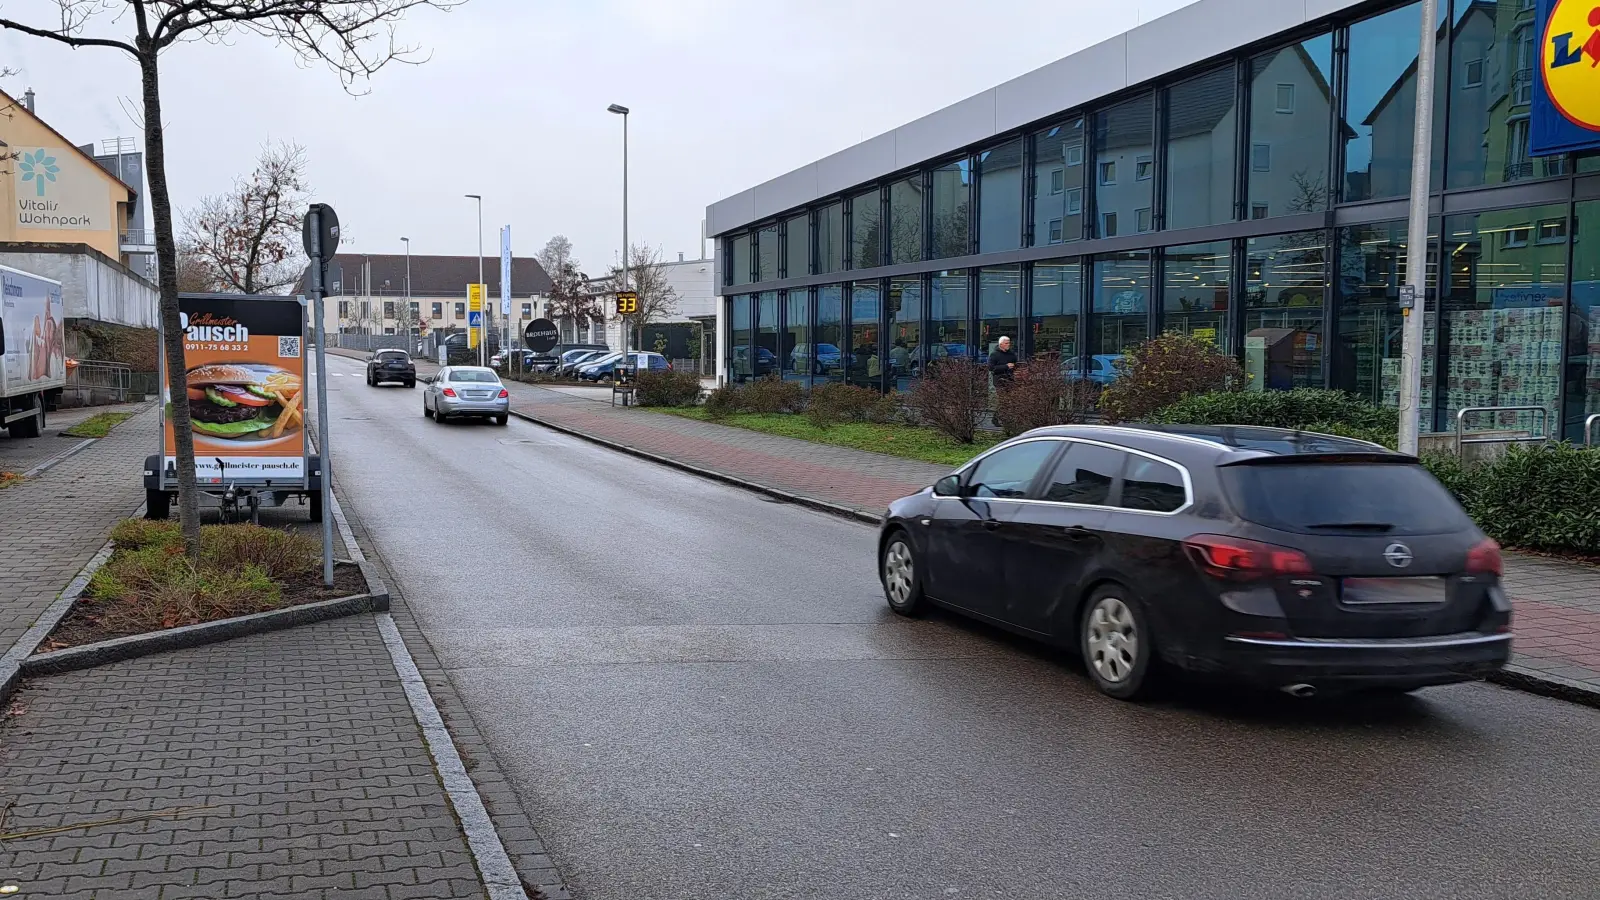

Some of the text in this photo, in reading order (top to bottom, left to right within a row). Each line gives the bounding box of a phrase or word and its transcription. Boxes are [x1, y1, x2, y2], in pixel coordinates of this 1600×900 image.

[19, 199, 59, 211] Vitalis
[19, 212, 91, 227] Wohnpark
[618, 298, 636, 312] 33
[190, 312, 238, 326] Grillmeister
[185, 343, 218, 351] 0911-75
[231, 343, 242, 352] 33
[243, 343, 249, 352] 2
